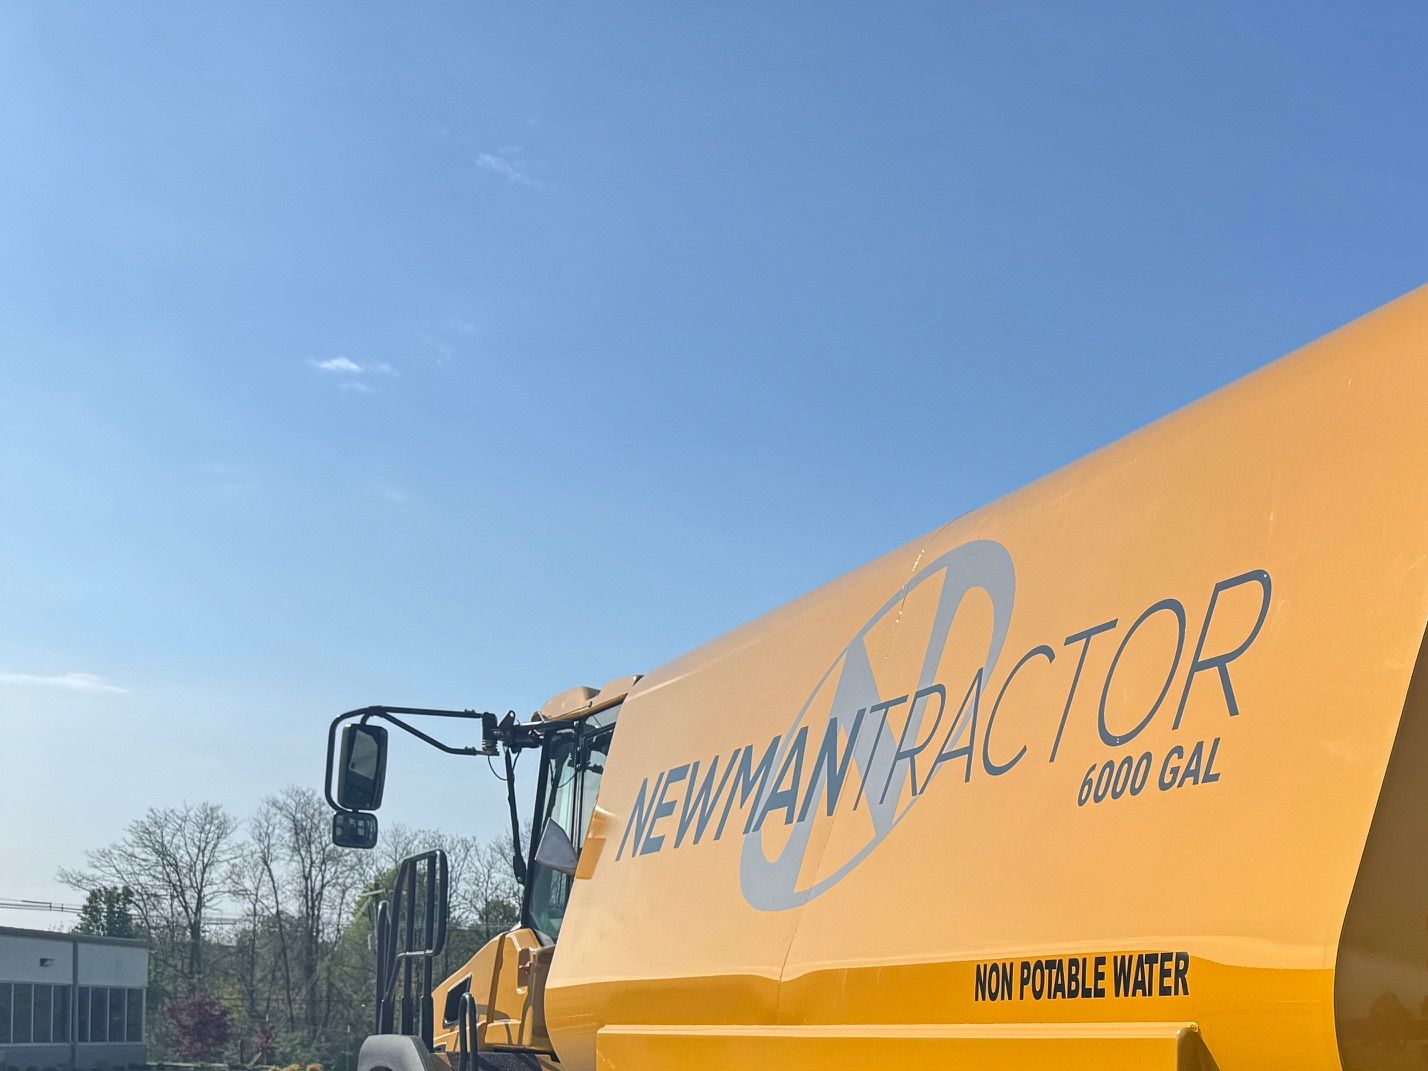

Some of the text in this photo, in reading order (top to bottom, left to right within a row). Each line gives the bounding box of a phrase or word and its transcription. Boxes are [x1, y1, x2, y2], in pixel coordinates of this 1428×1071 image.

[1077, 737, 1221, 807] 6000 GAL
[974, 951, 1190, 1001] NON POTABLE WATER
